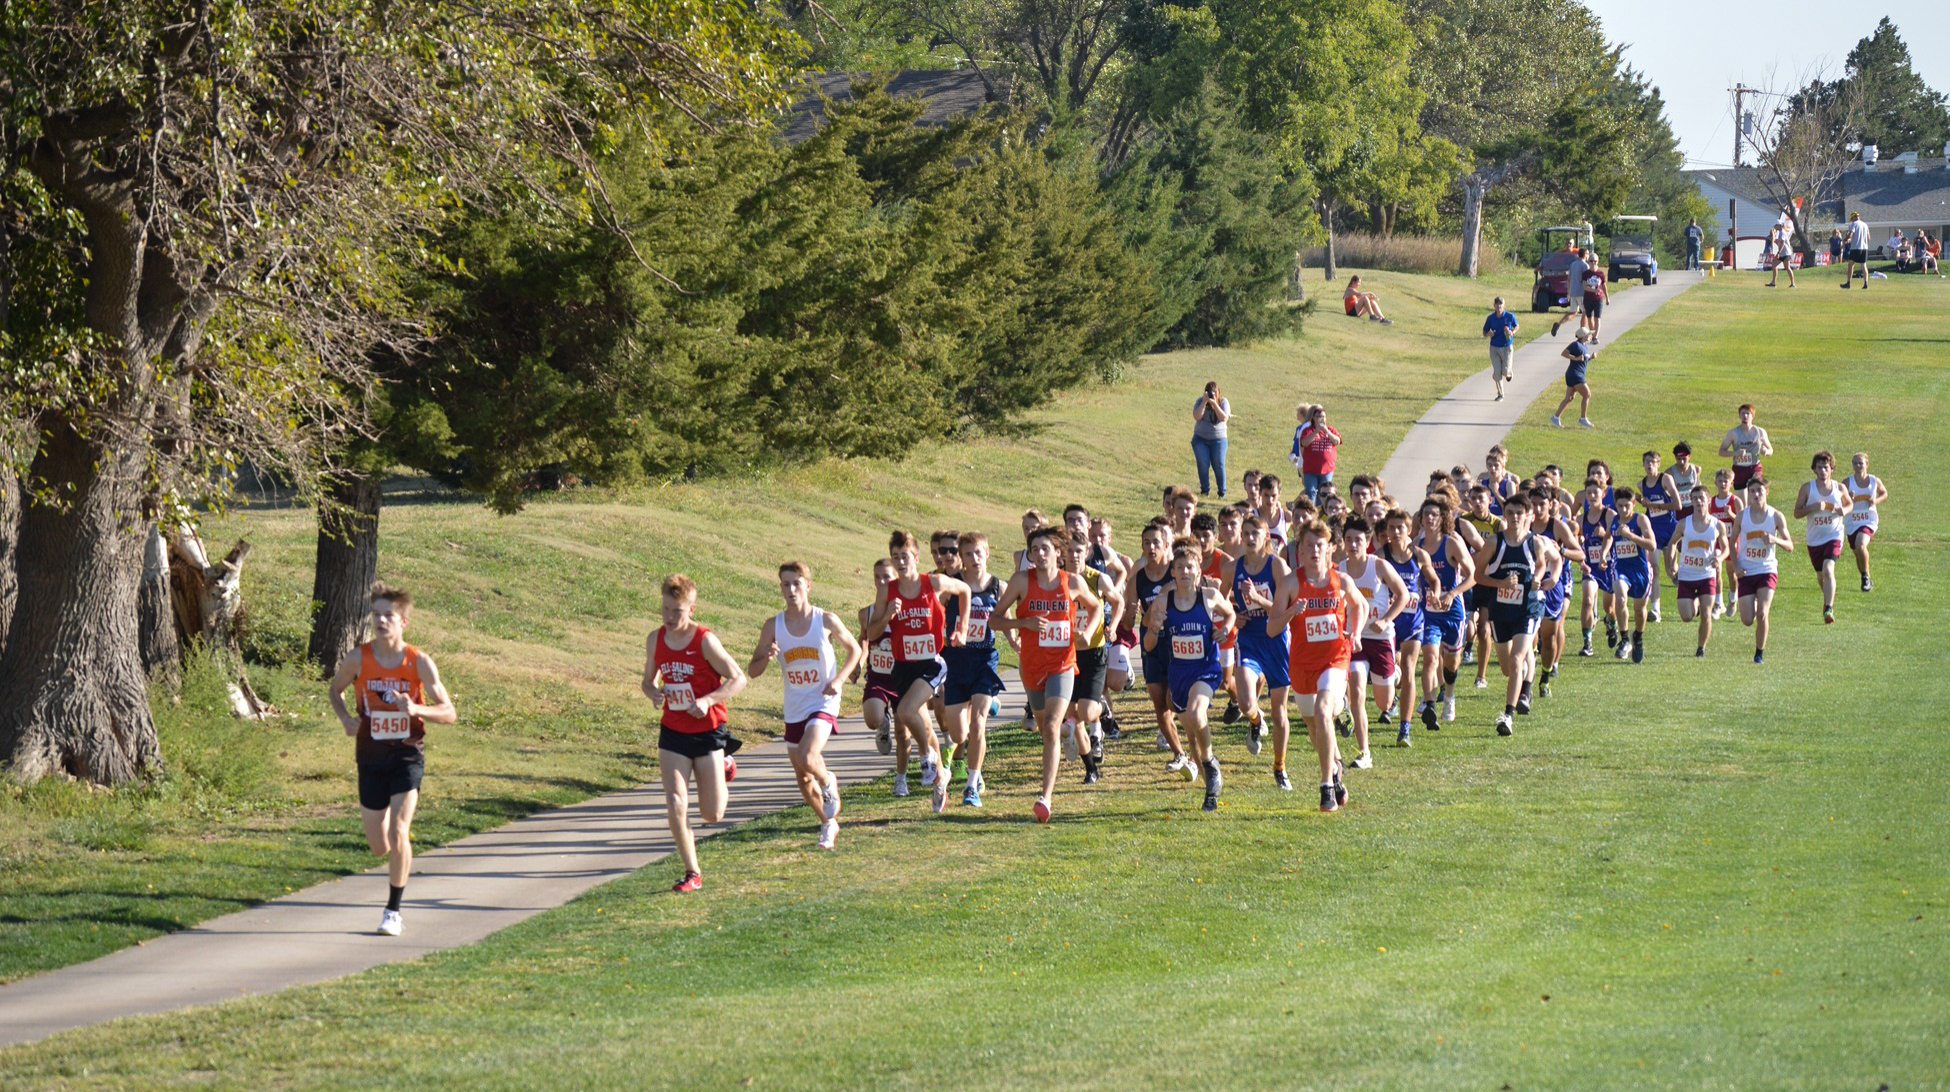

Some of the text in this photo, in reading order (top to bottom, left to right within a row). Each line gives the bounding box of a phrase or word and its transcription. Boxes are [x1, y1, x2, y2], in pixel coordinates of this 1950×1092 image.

[1814, 516, 1832, 526] 5545
[1852, 513, 1869, 521] 5546
[1617, 544, 1637, 555] 5592
[1746, 548, 1767, 558] 5540
[1684, 555, 1704, 567] 5543
[1498, 587, 1522, 600] 5677
[898, 607, 932, 621] ELL-SALINE
[1040, 626, 1070, 641] 5436
[1307, 621, 1337, 637] 5434
[904, 639, 935, 655] 5476
[1173, 640, 1203, 655] 5683
[873, 654, 893, 669] 566
[787, 669, 820, 685] 5542
[366, 680, 400, 692] TROJAN
[372, 717, 408, 733] 5450
